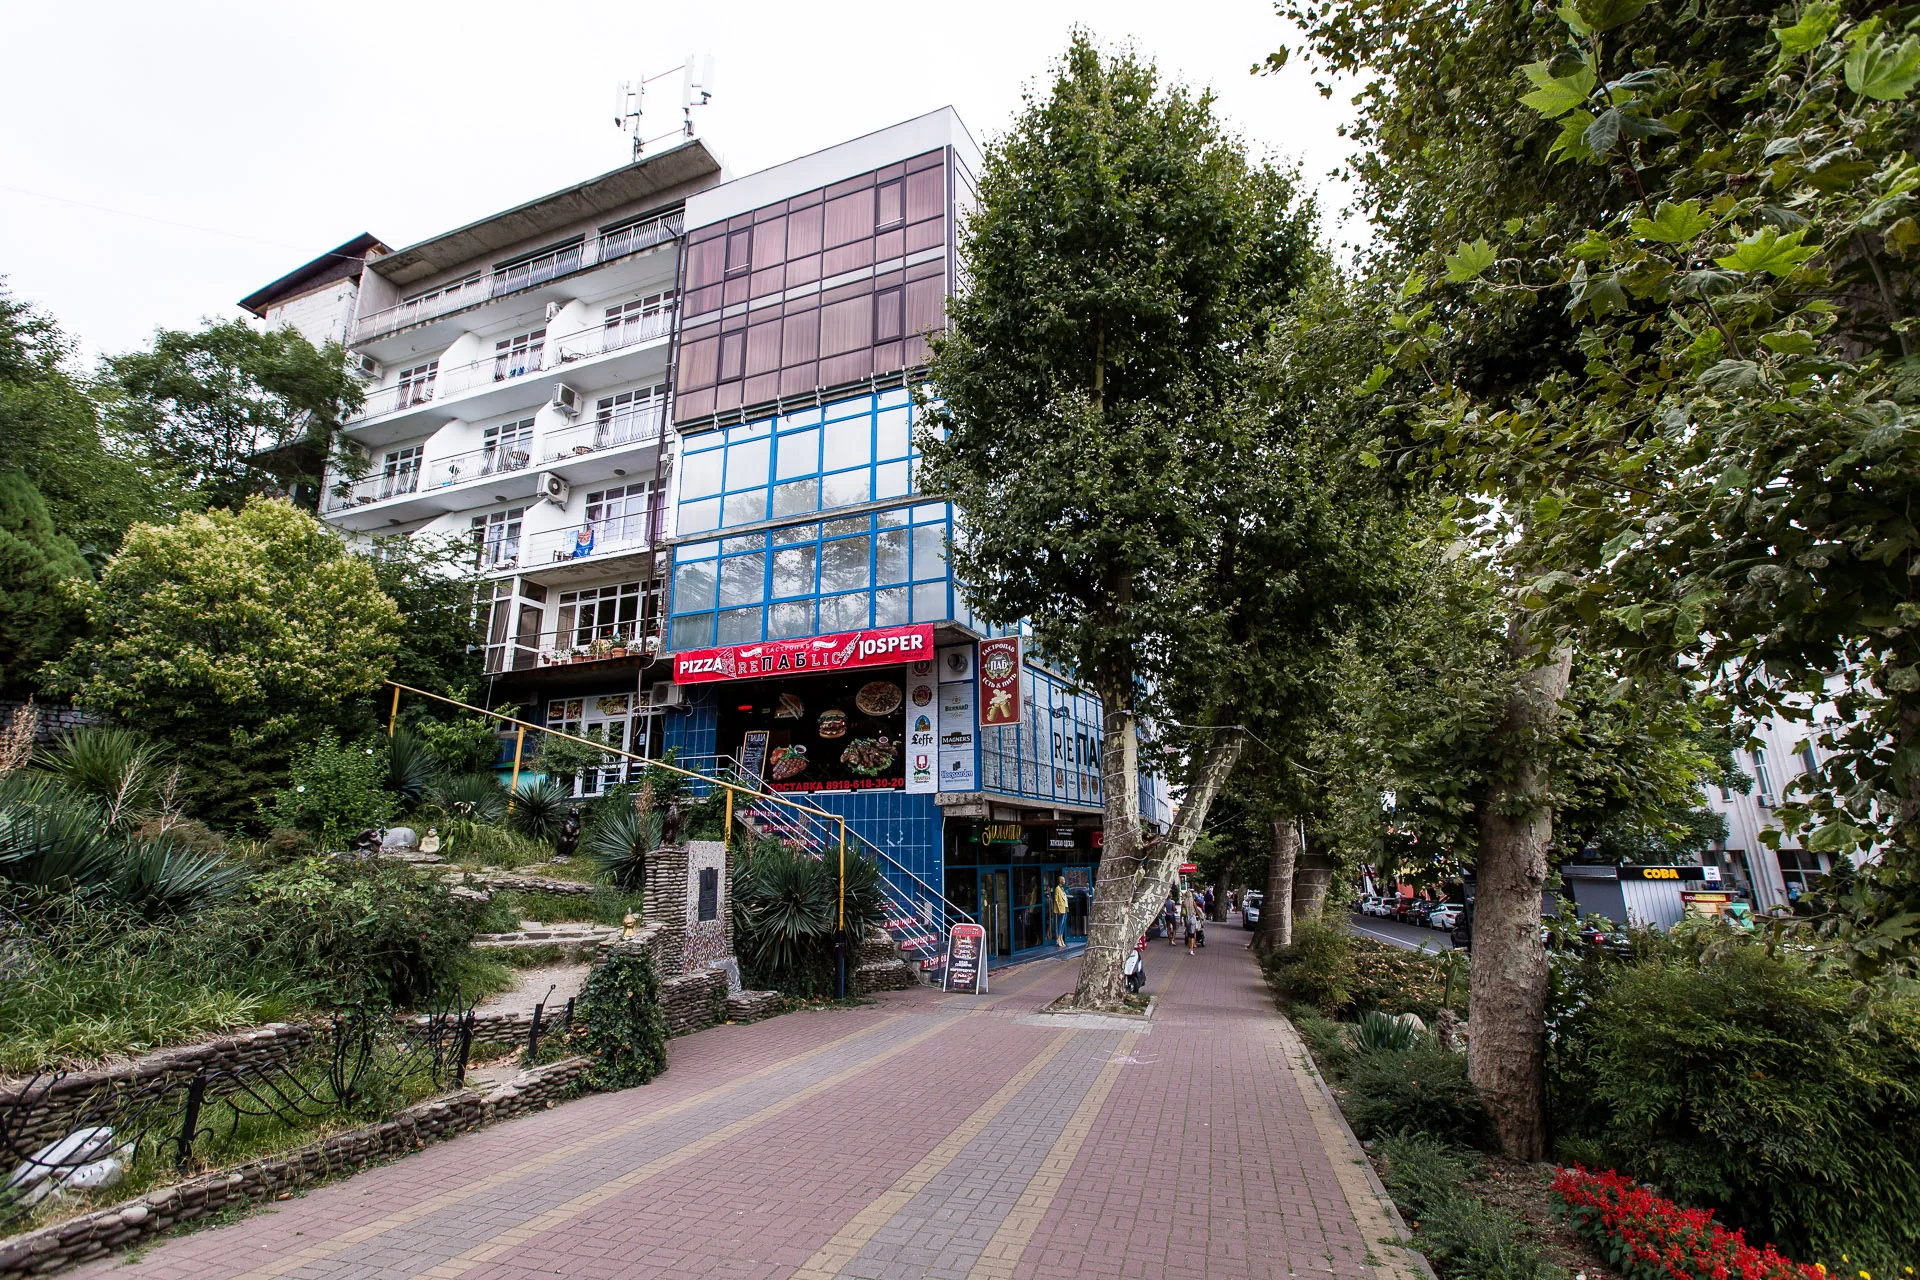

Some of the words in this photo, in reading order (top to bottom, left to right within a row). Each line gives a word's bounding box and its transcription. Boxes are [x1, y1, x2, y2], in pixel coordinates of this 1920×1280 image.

[765, 643, 810, 653] ГАСТРОПАБ
[859, 634, 923, 660] JOSPER
[981, 643, 1016, 656] ГАСТРОПАБ
[679, 657, 723, 674] PIZZA
[982, 677, 995, 689] ЕСТЬ
[1001, 673, 1017, 688] ПИТЬ
[911, 733, 933, 747] Leffe
[942, 736, 971, 744] MAGNERS
[940, 769, 973, 779] Hoegaarden
[767, 781, 824, 794] ДОСТАВКА
[826, 777, 905, 790] 8918-618-30-20
